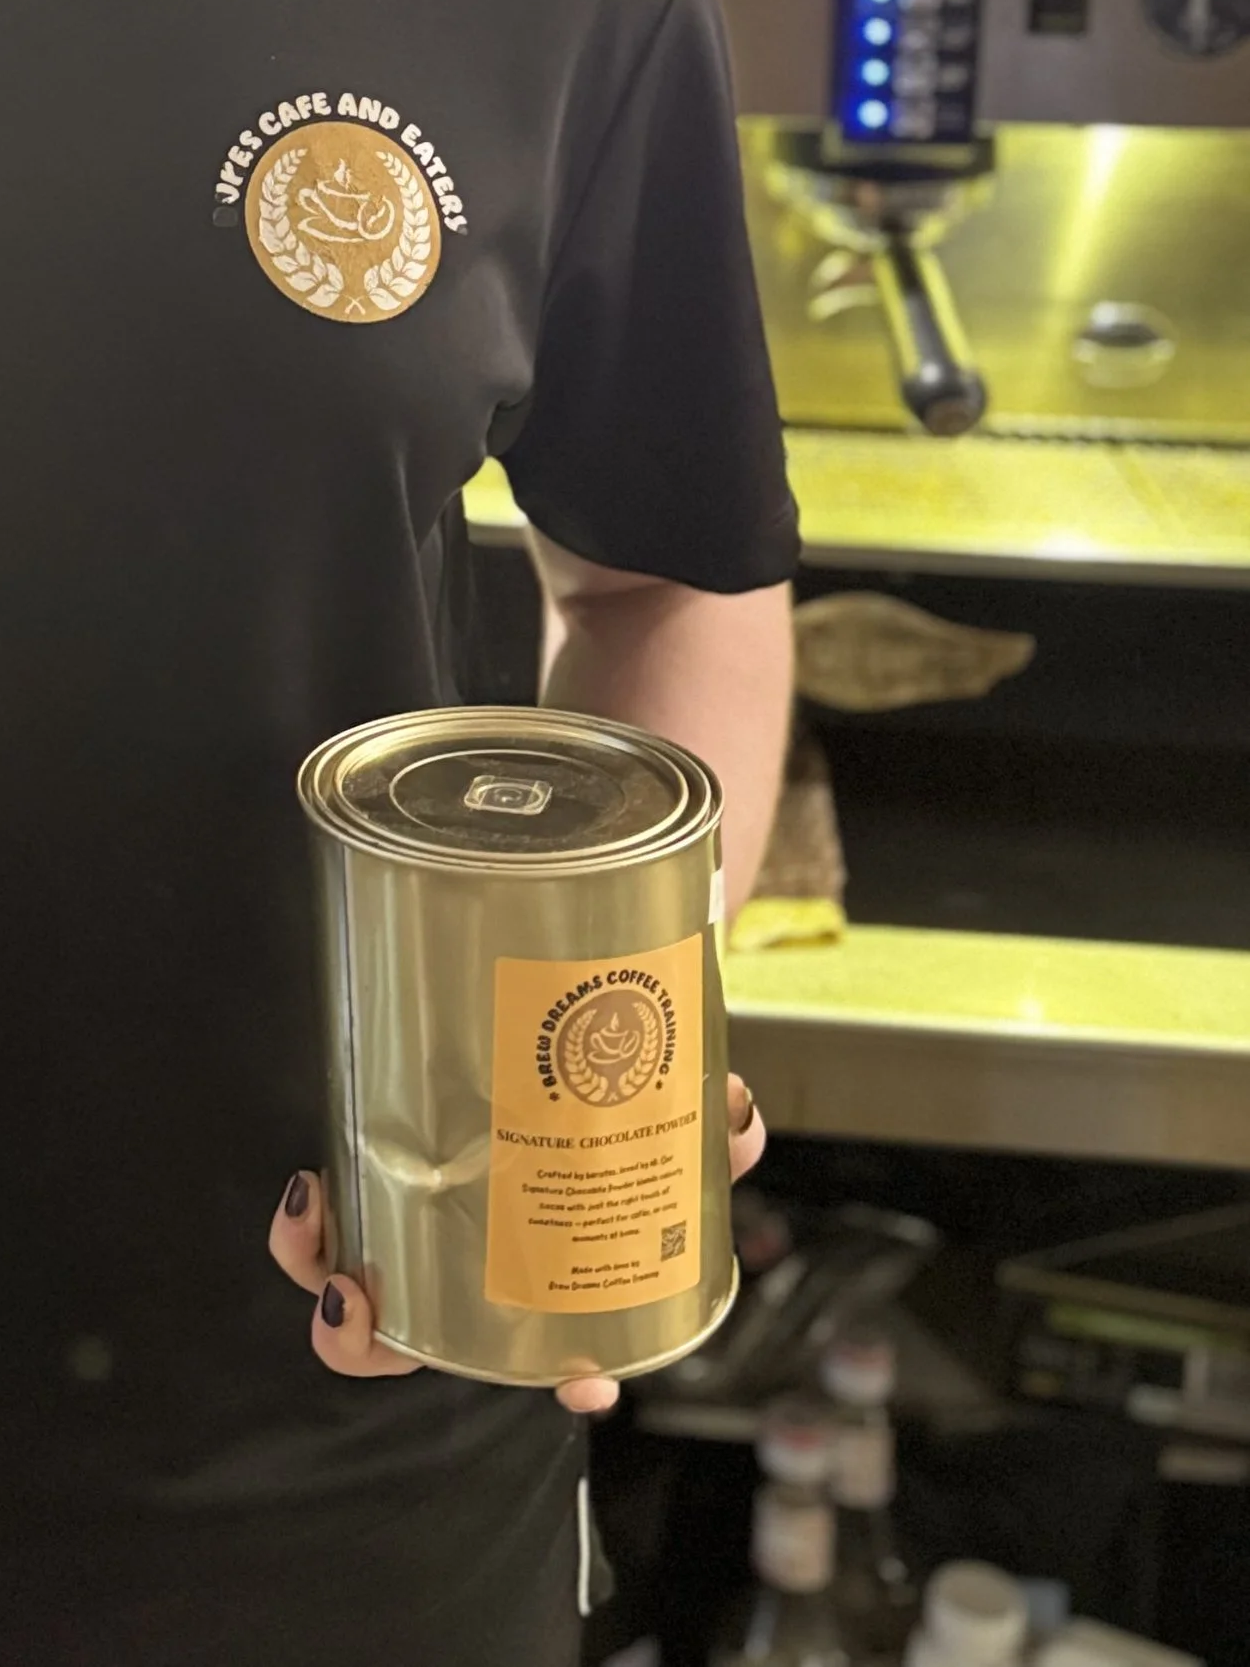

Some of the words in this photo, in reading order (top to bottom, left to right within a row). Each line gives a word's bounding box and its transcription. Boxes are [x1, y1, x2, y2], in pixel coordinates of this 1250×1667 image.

[258, 92, 332, 135] CAFE
[337, 92, 400, 130] AND
[541, 975, 603, 1033] DREAMS
[606, 969, 660, 994] COFFEE
[657, 988, 677, 1076] TRAINING
[536, 1035, 557, 1087] BREW
[497, 1128, 575, 1150] SIGNATURE
[579, 1124, 654, 1150] CHOCOLATE
[655, 1111, 698, 1135] POWDER
